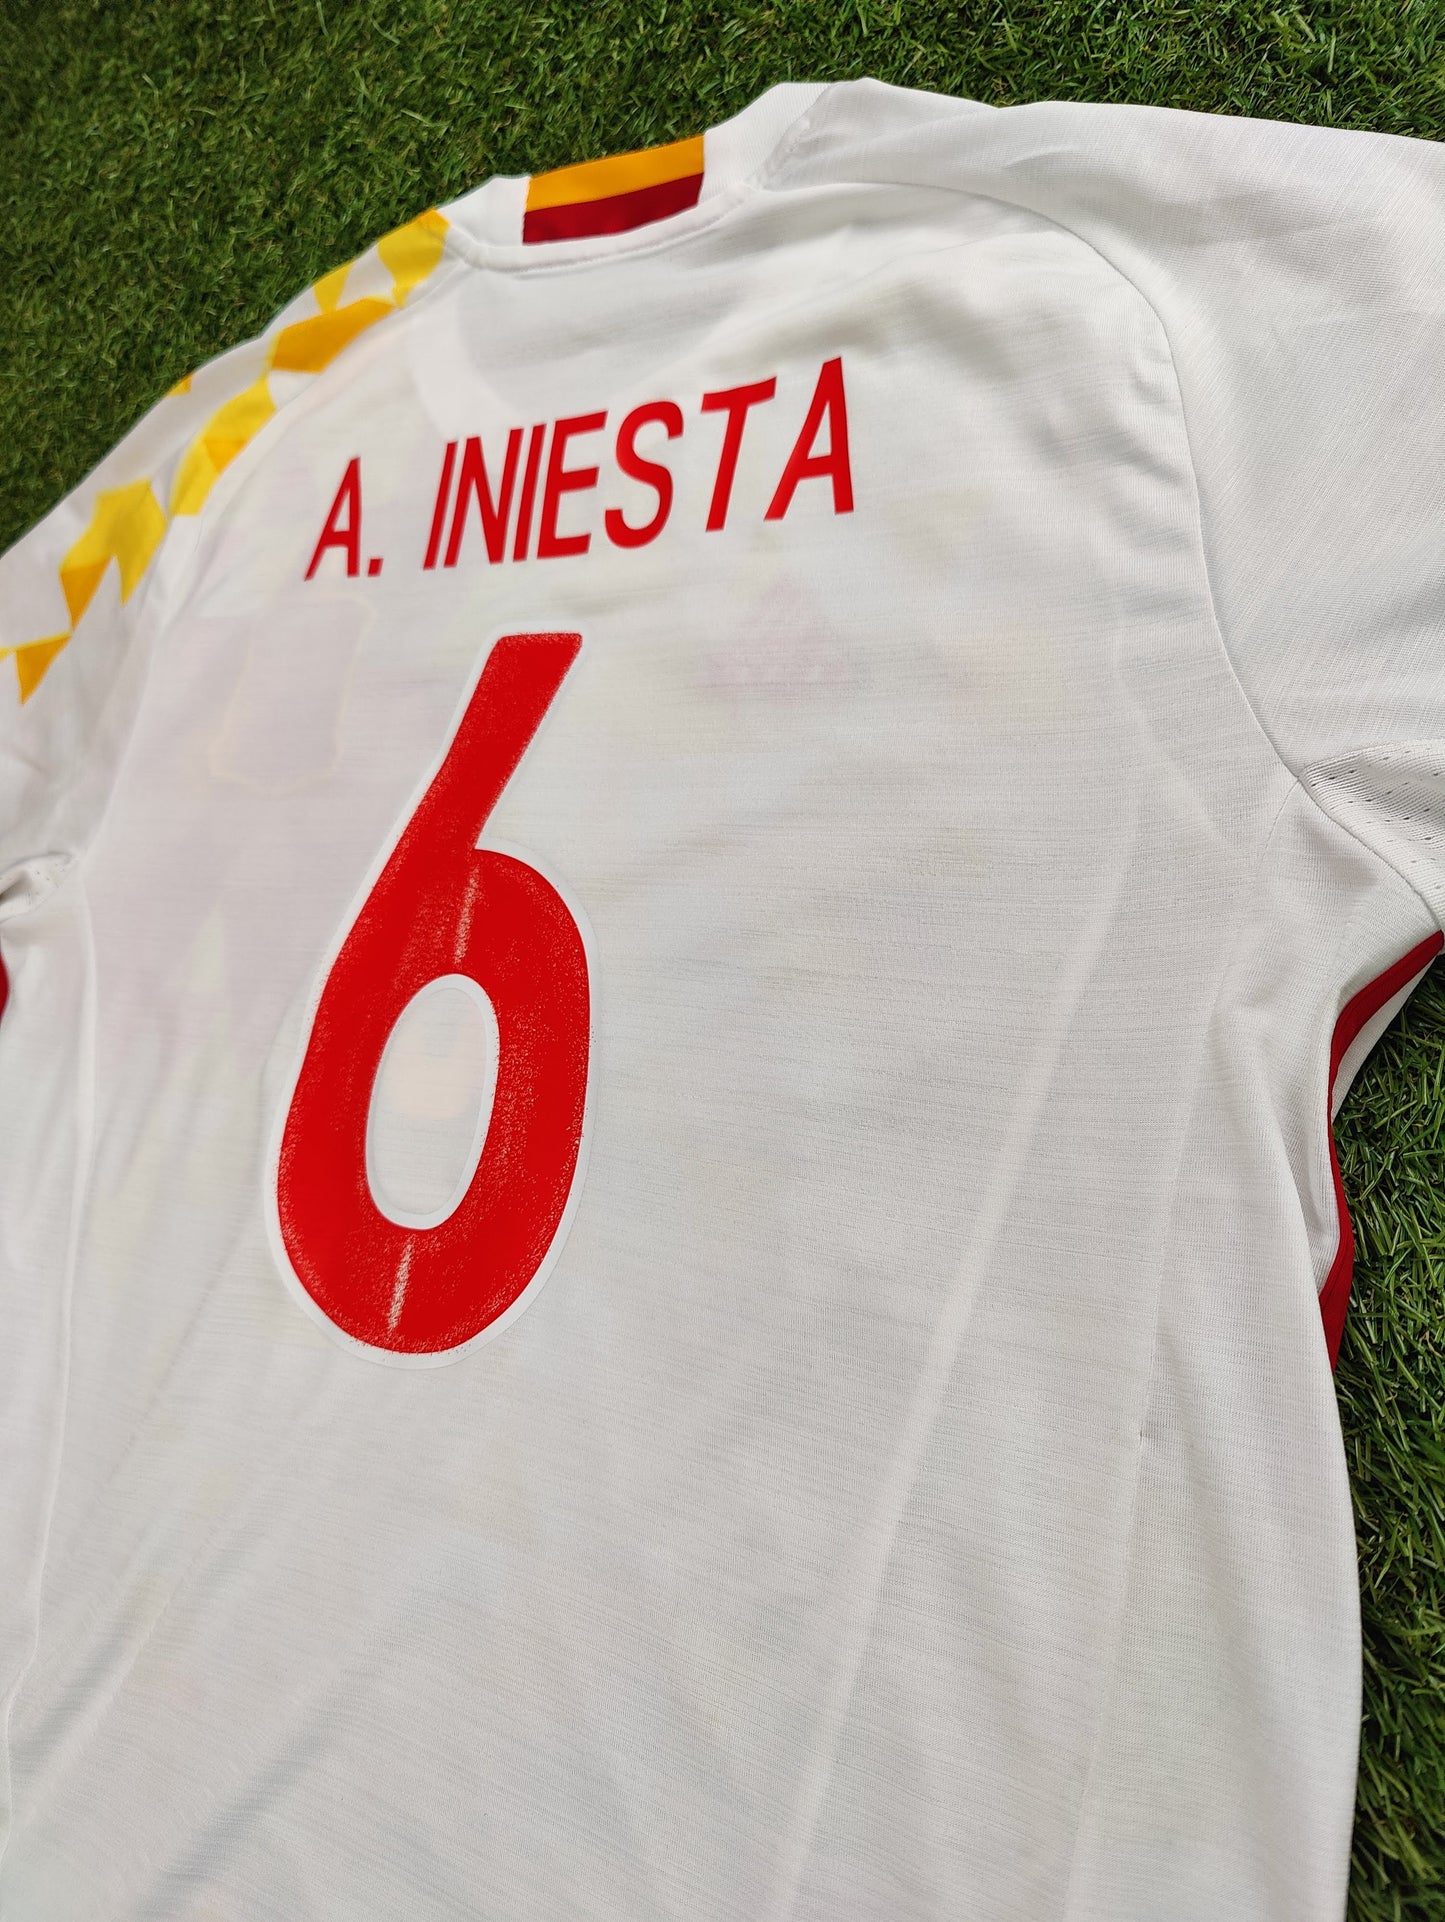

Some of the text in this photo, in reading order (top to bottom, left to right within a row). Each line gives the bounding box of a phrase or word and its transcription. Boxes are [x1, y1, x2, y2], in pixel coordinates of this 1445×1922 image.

[304, 356, 855, 581] A. INIESTA
[276, 632, 591, 1355] 6
